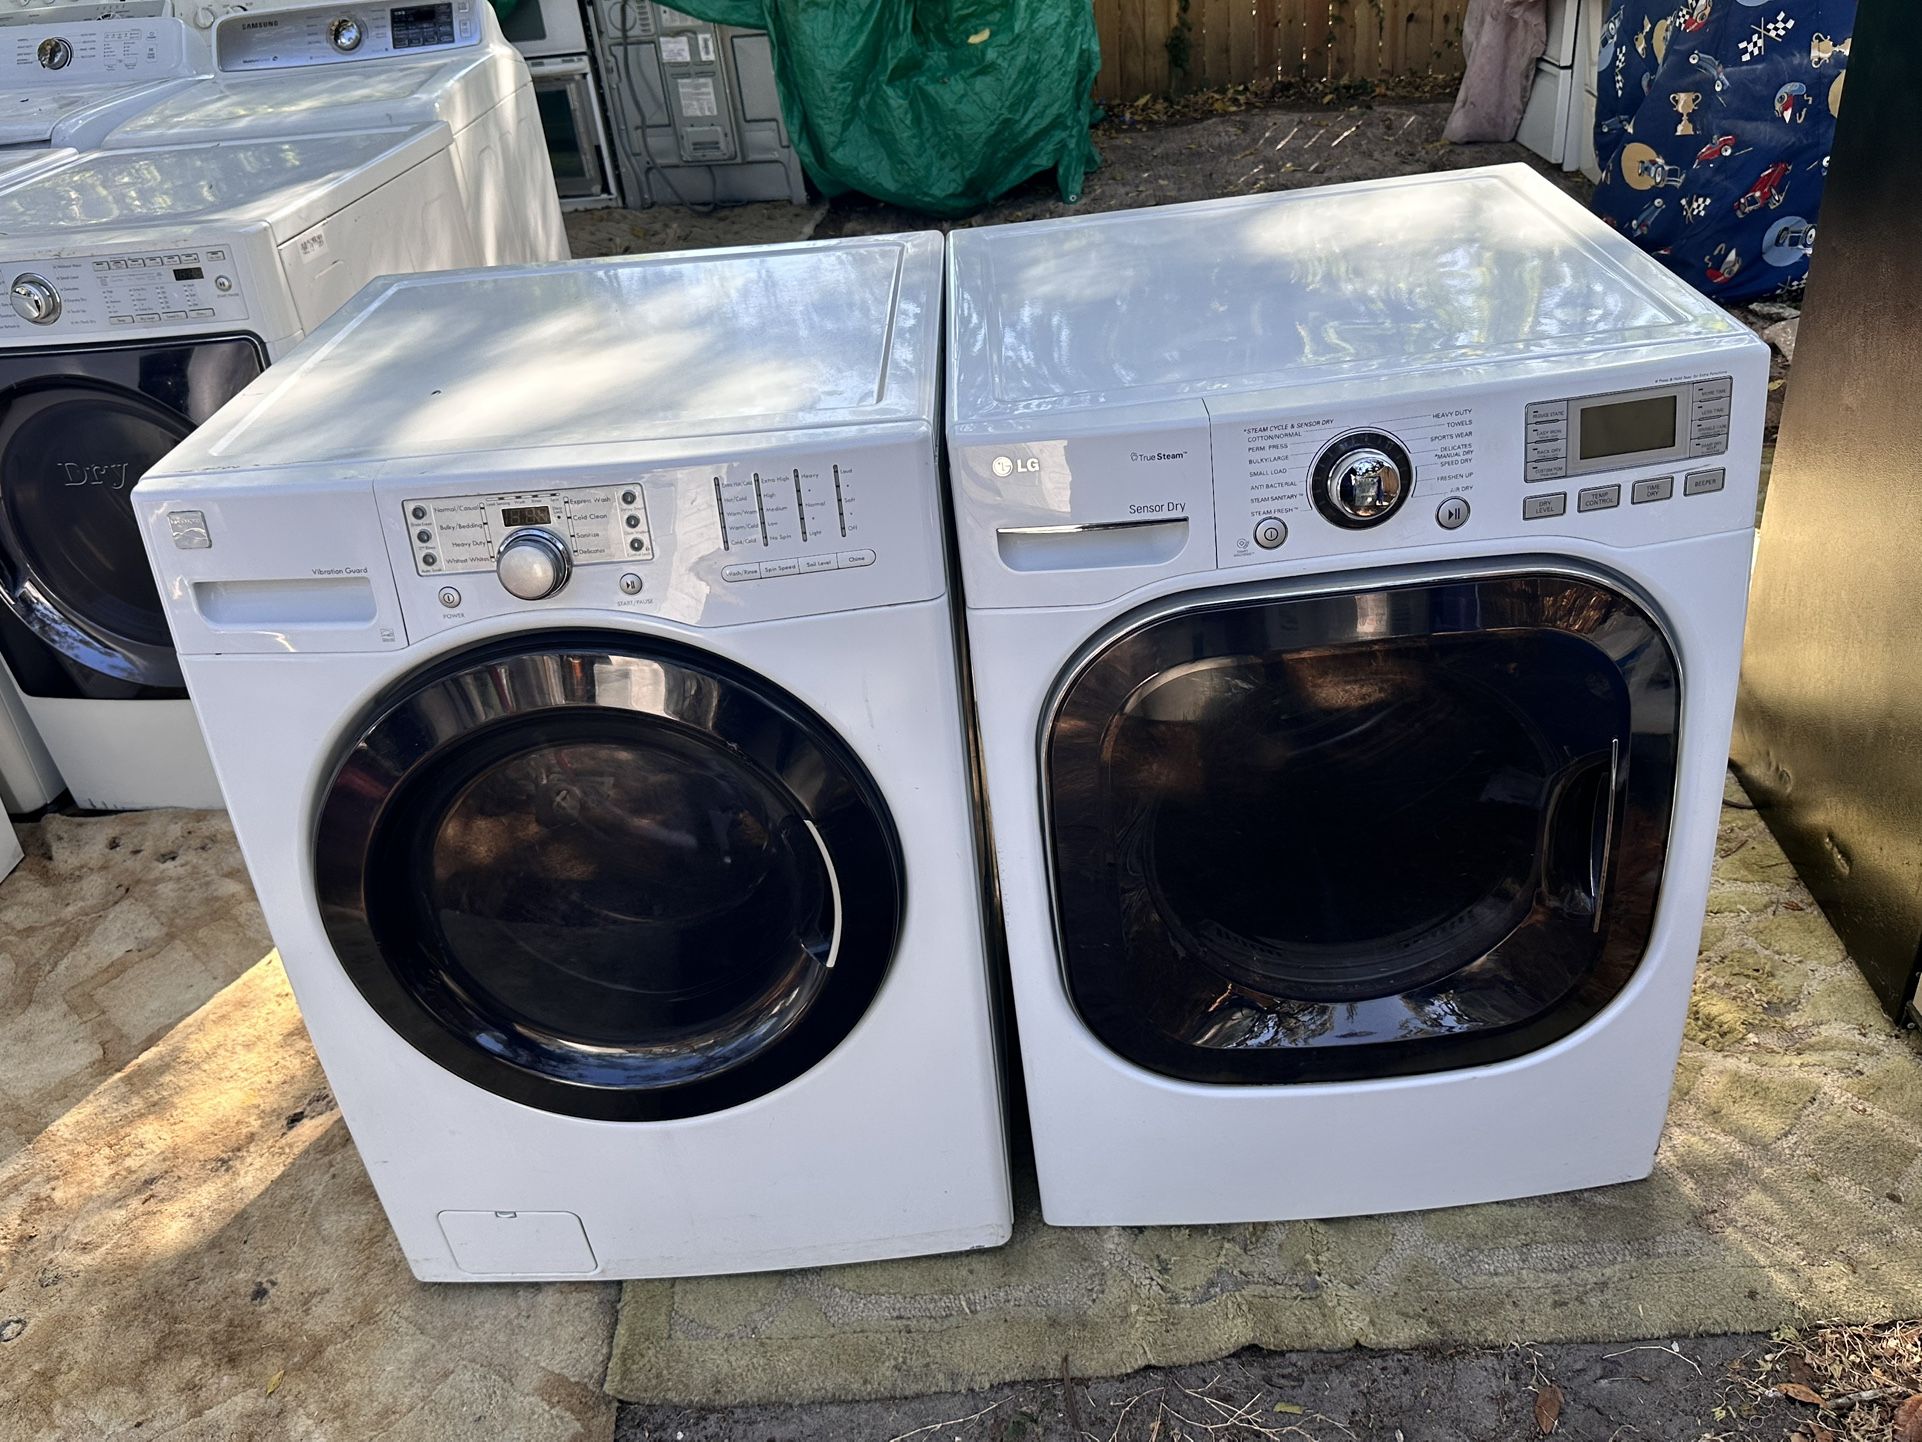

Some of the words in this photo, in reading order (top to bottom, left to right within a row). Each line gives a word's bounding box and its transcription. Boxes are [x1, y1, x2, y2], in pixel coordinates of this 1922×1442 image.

[242, 20, 279, 31] SAMSUNG
[1454, 408, 1472, 416] DUTY
[1270, 424, 1288, 432] CYCLE
[1296, 420, 1320, 428] SENSOR
[1446, 420, 1472, 428] TOWELS
[1248, 431, 1302, 442] COTTON/NORMAL
[1430, 434, 1454, 442] SPORTS
[1440, 443, 1472, 452] DELICATES
[1017, 458, 1040, 472] LG
[57, 462, 129, 490] Dry
[1694, 478, 1716, 488] BEEPER
[1592, 492, 1608, 500] TEMP
[1586, 497, 1614, 506] CONTROL
[434, 504, 479, 512] Normal/Casual
[1129, 503, 1164, 514] Sensor
[1167, 501, 1186, 513] Dry
[440, 523, 483, 531] Bulky/Bedding
